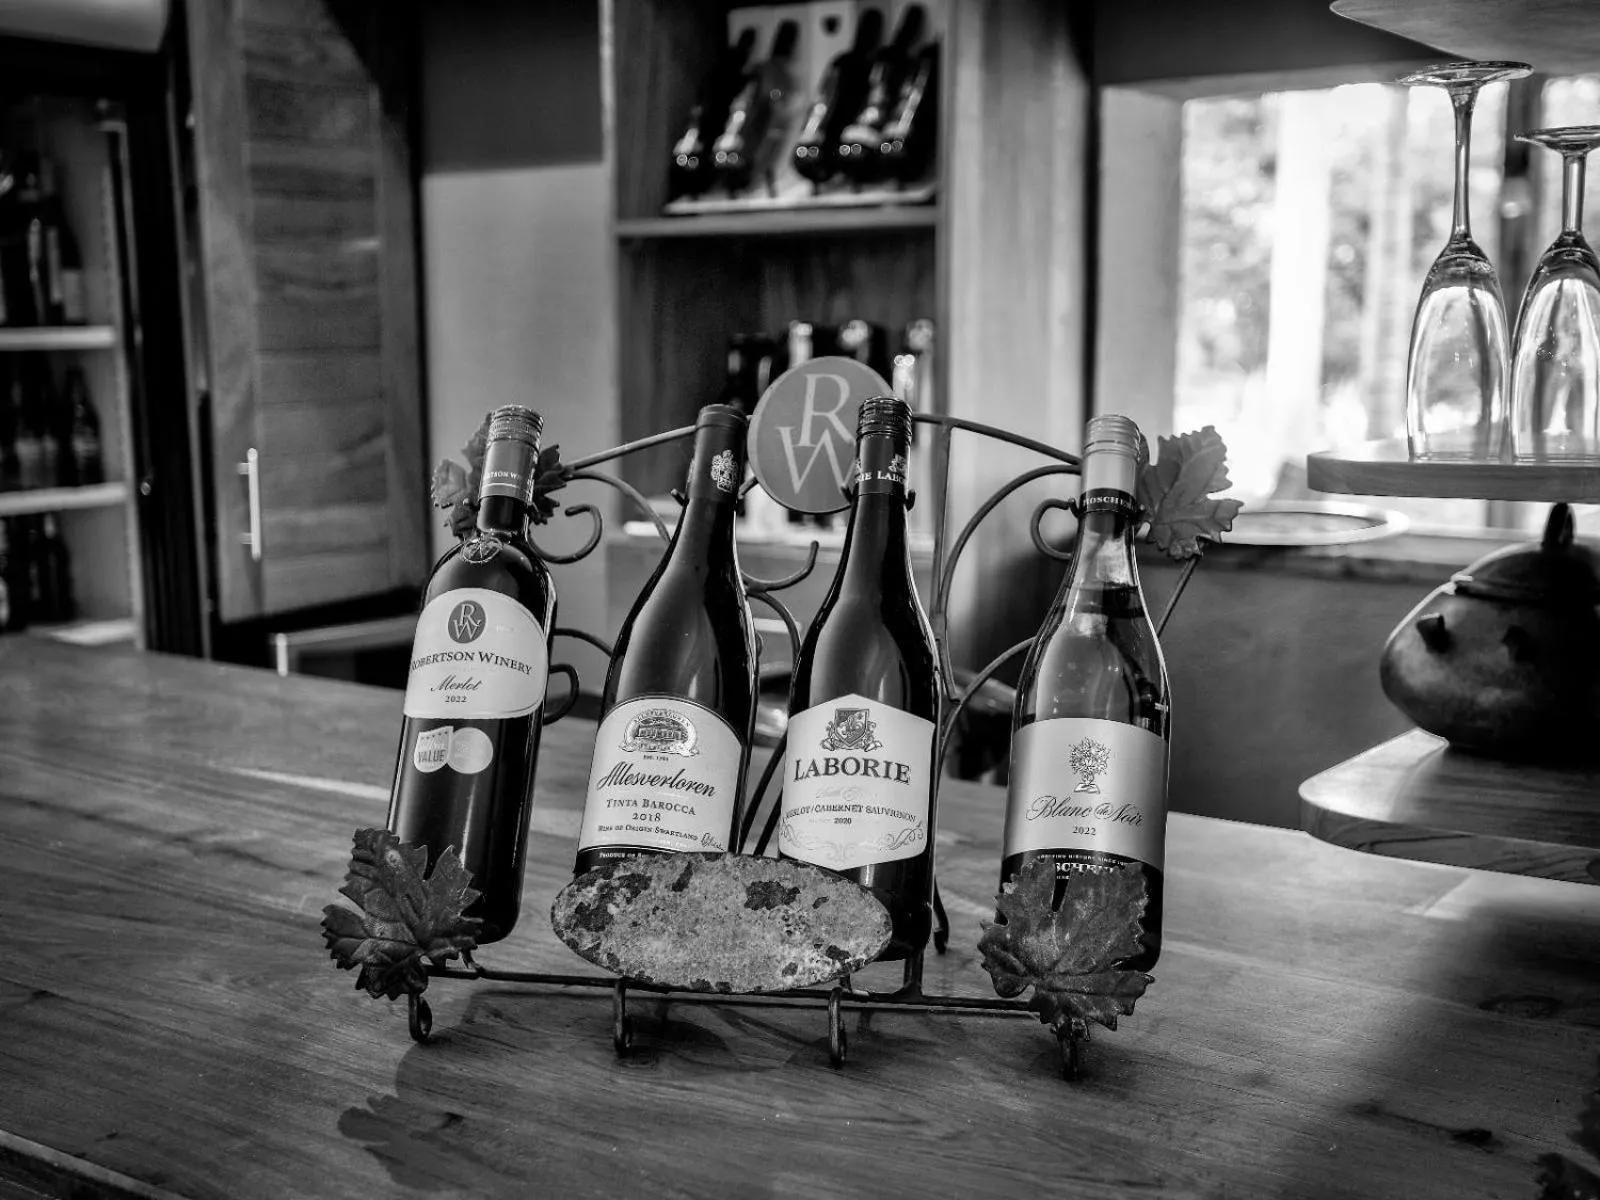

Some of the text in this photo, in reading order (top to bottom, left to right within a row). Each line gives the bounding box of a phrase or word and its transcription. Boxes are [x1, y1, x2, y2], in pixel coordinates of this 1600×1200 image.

[478, 650, 533, 676] WINERY
[430, 674, 484, 692] Merlot
[444, 695, 468, 704] 2022
[417, 748, 447, 763] VALUE
[596, 761, 716, 798] Allesverloren
[792, 756, 912, 785] LABORIE
[606, 798, 697, 816] TINTA BAROCCA
[865, 805, 917, 823] SAUVIGNON
[1025, 795, 1094, 821] Blanc
[1111, 802, 1146, 827] Noir
[632, 812, 662, 823] 2018
[1072, 825, 1097, 836] 2022
